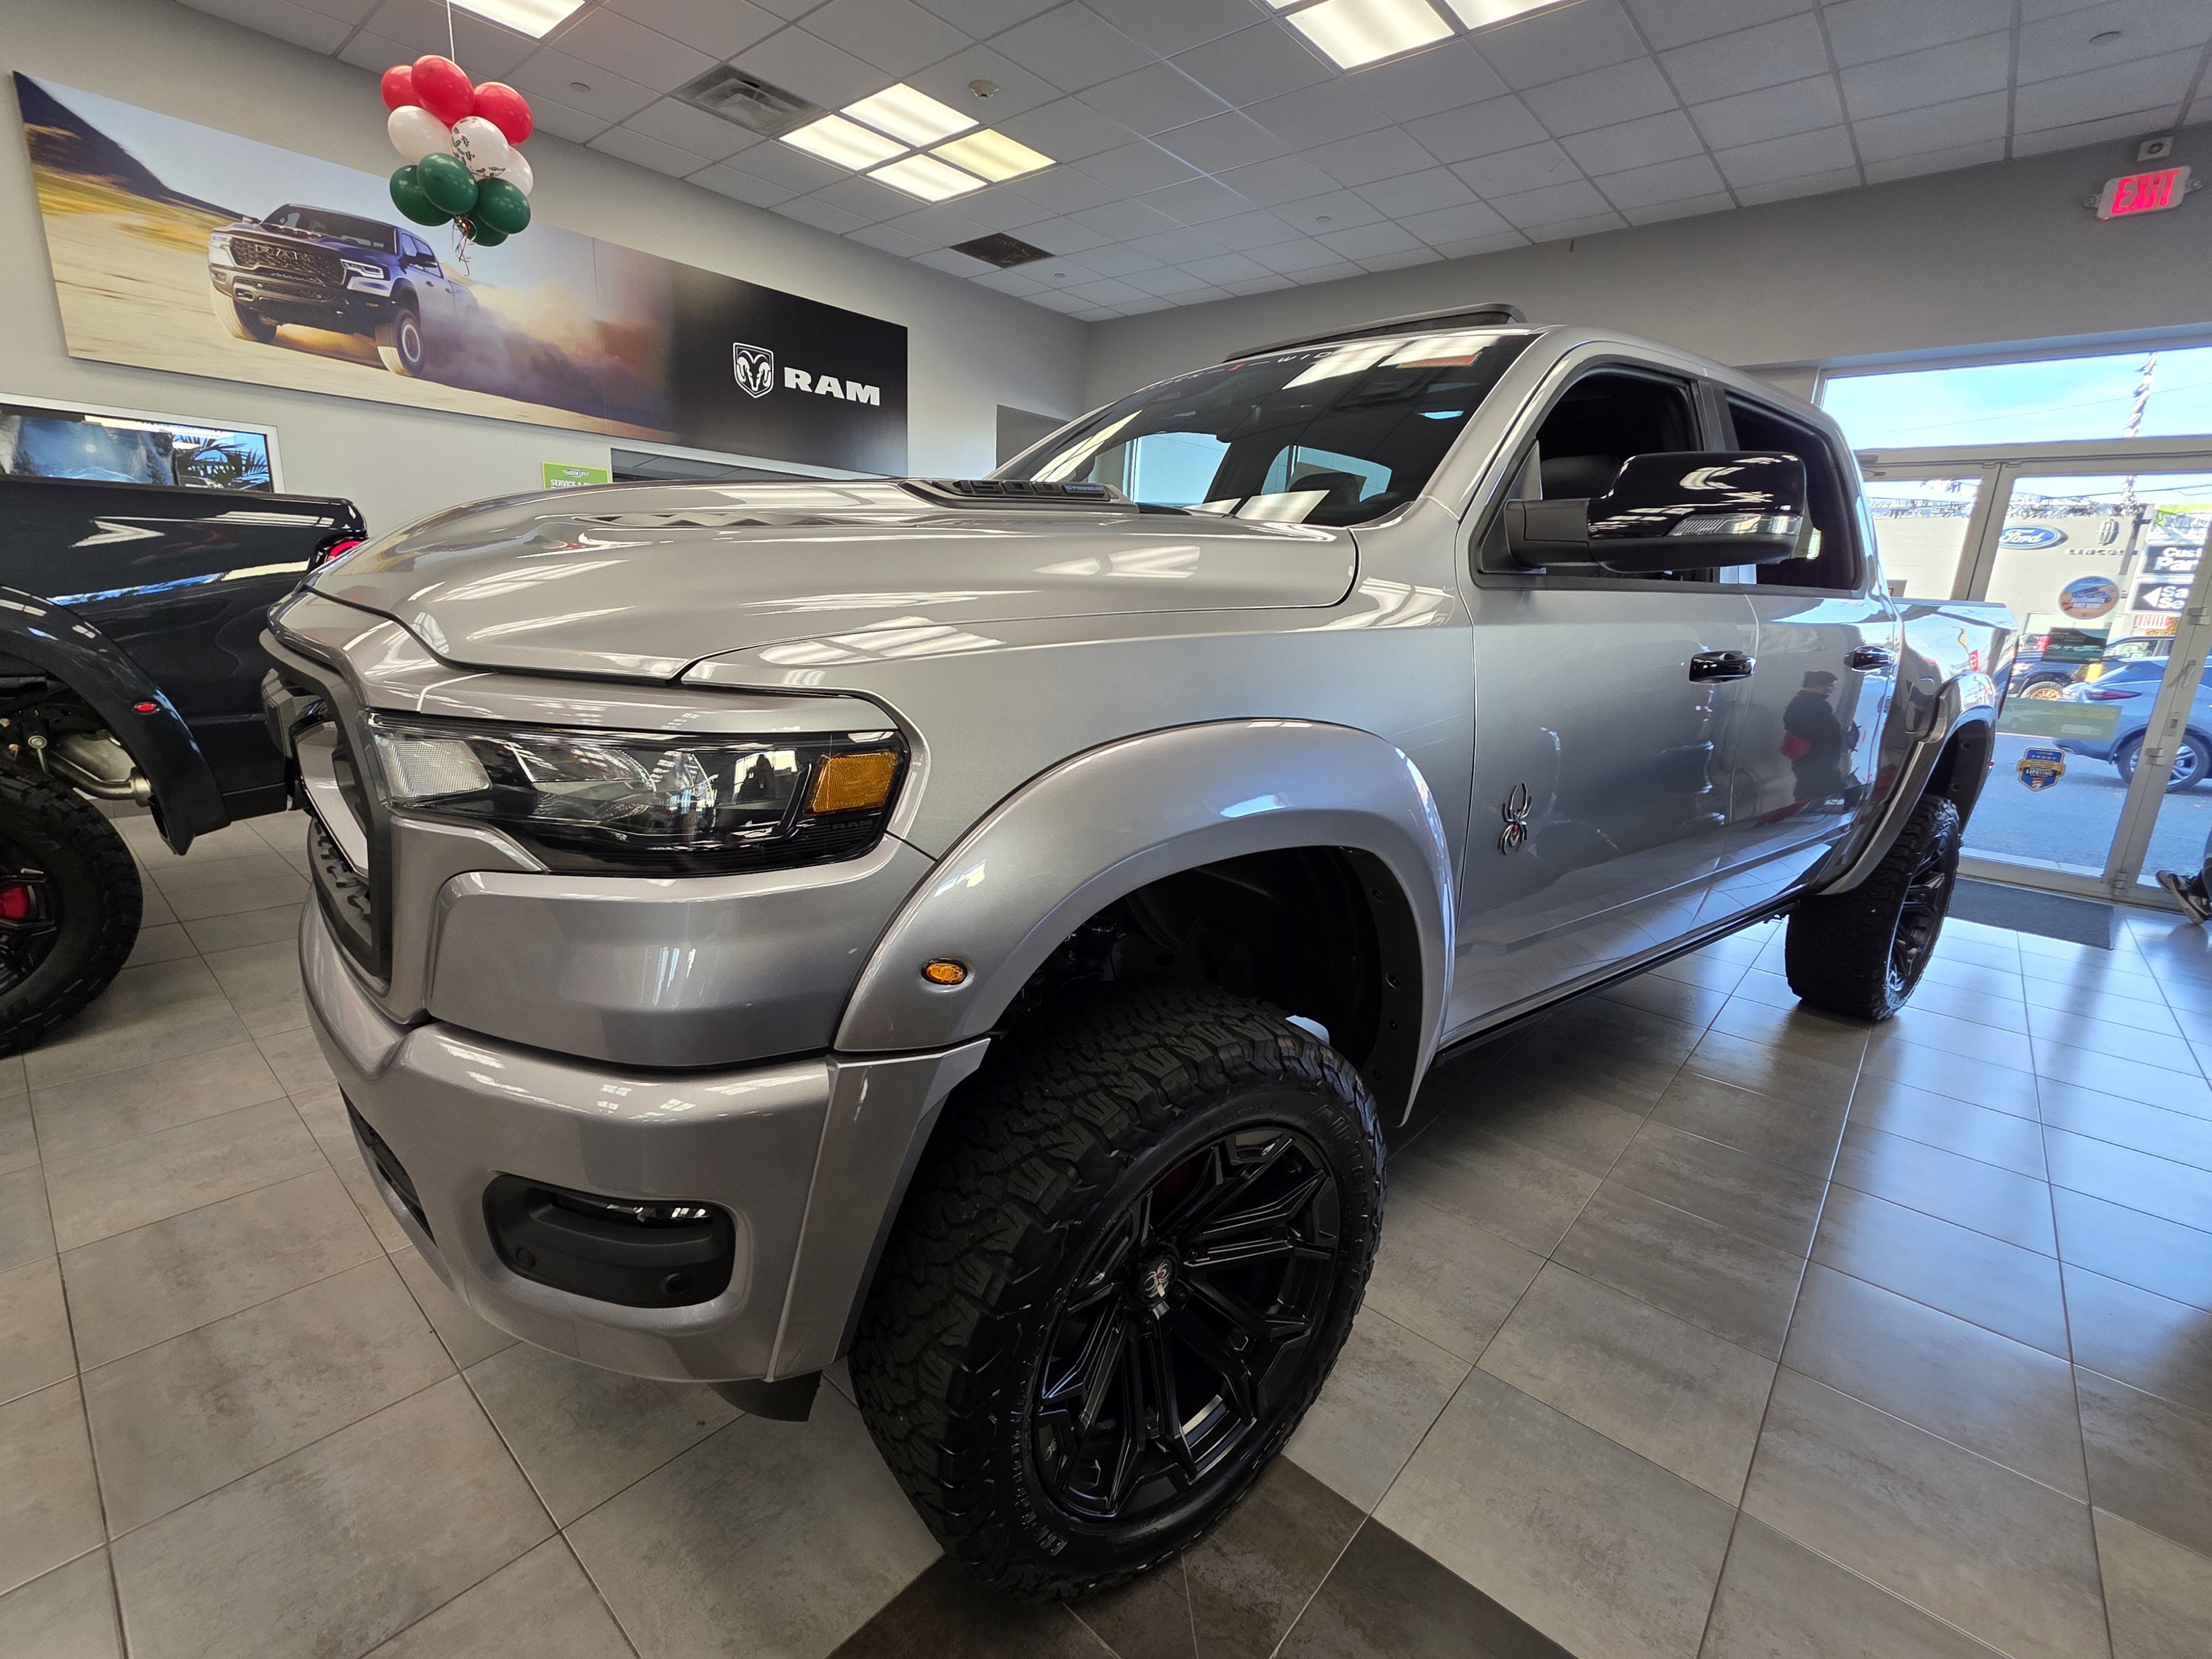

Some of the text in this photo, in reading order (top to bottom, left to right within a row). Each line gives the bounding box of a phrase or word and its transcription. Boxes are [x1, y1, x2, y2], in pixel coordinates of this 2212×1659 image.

[2111, 169, 2183, 215] EXIT
[254, 244, 315, 263] RAM
[784, 366, 880, 406] RAM
[550, 479, 576, 487] SERVICE
[952, 480, 1062, 495] 1500
[1999, 529, 2044, 543] Ford
[832, 819, 873, 830] RAM
